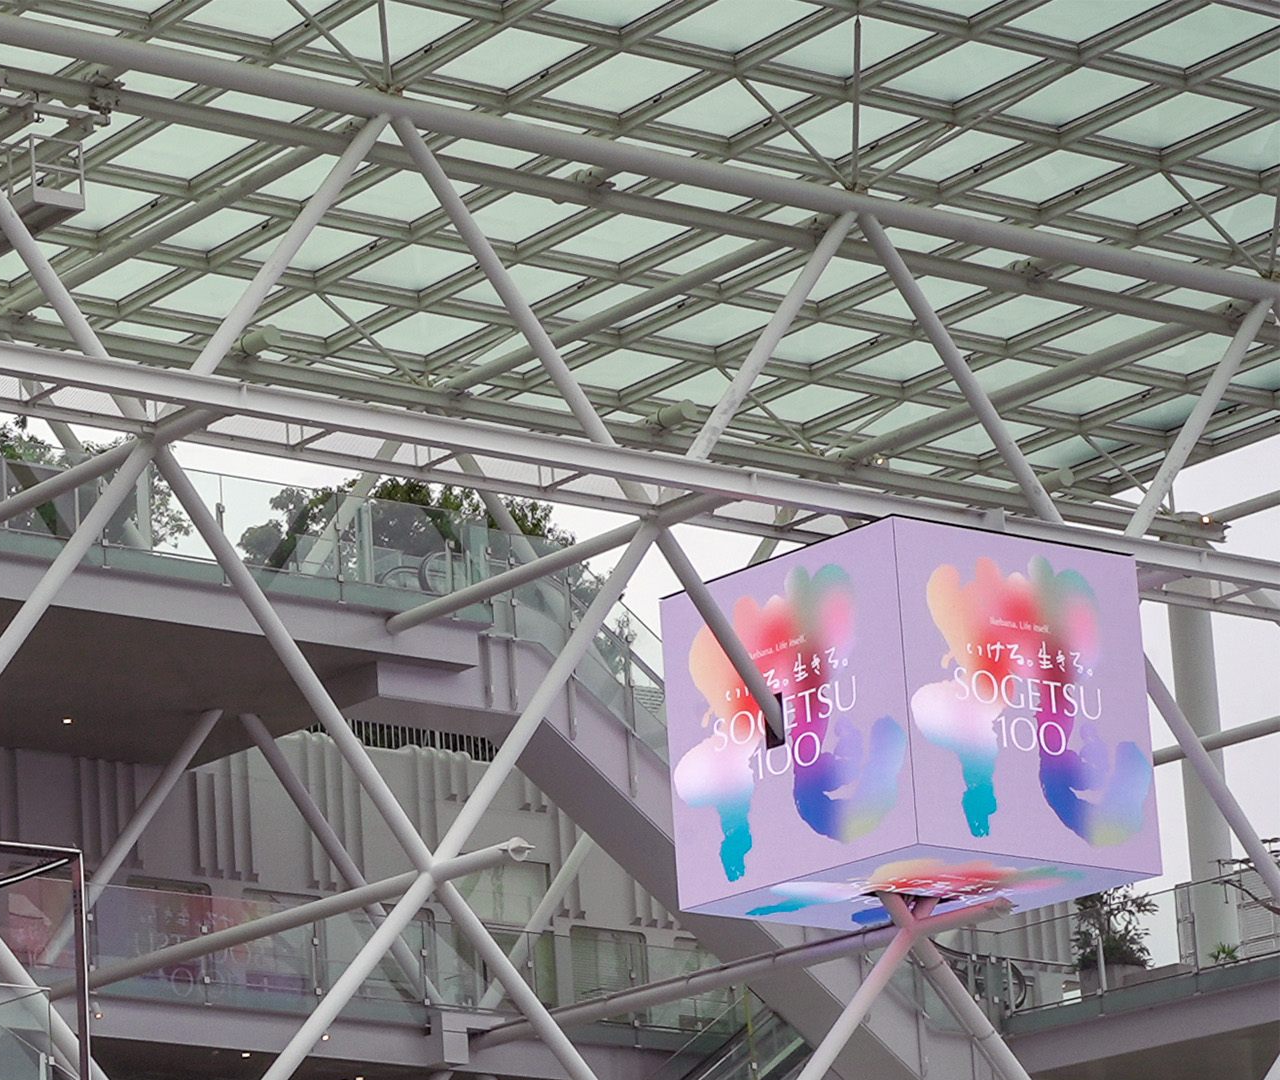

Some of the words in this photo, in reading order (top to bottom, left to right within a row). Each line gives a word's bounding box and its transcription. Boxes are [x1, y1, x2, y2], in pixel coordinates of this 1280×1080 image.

[953, 666, 1102, 721] SOGETSU
[753, 731, 821, 780] 100
[996, 715, 1067, 756] 100
